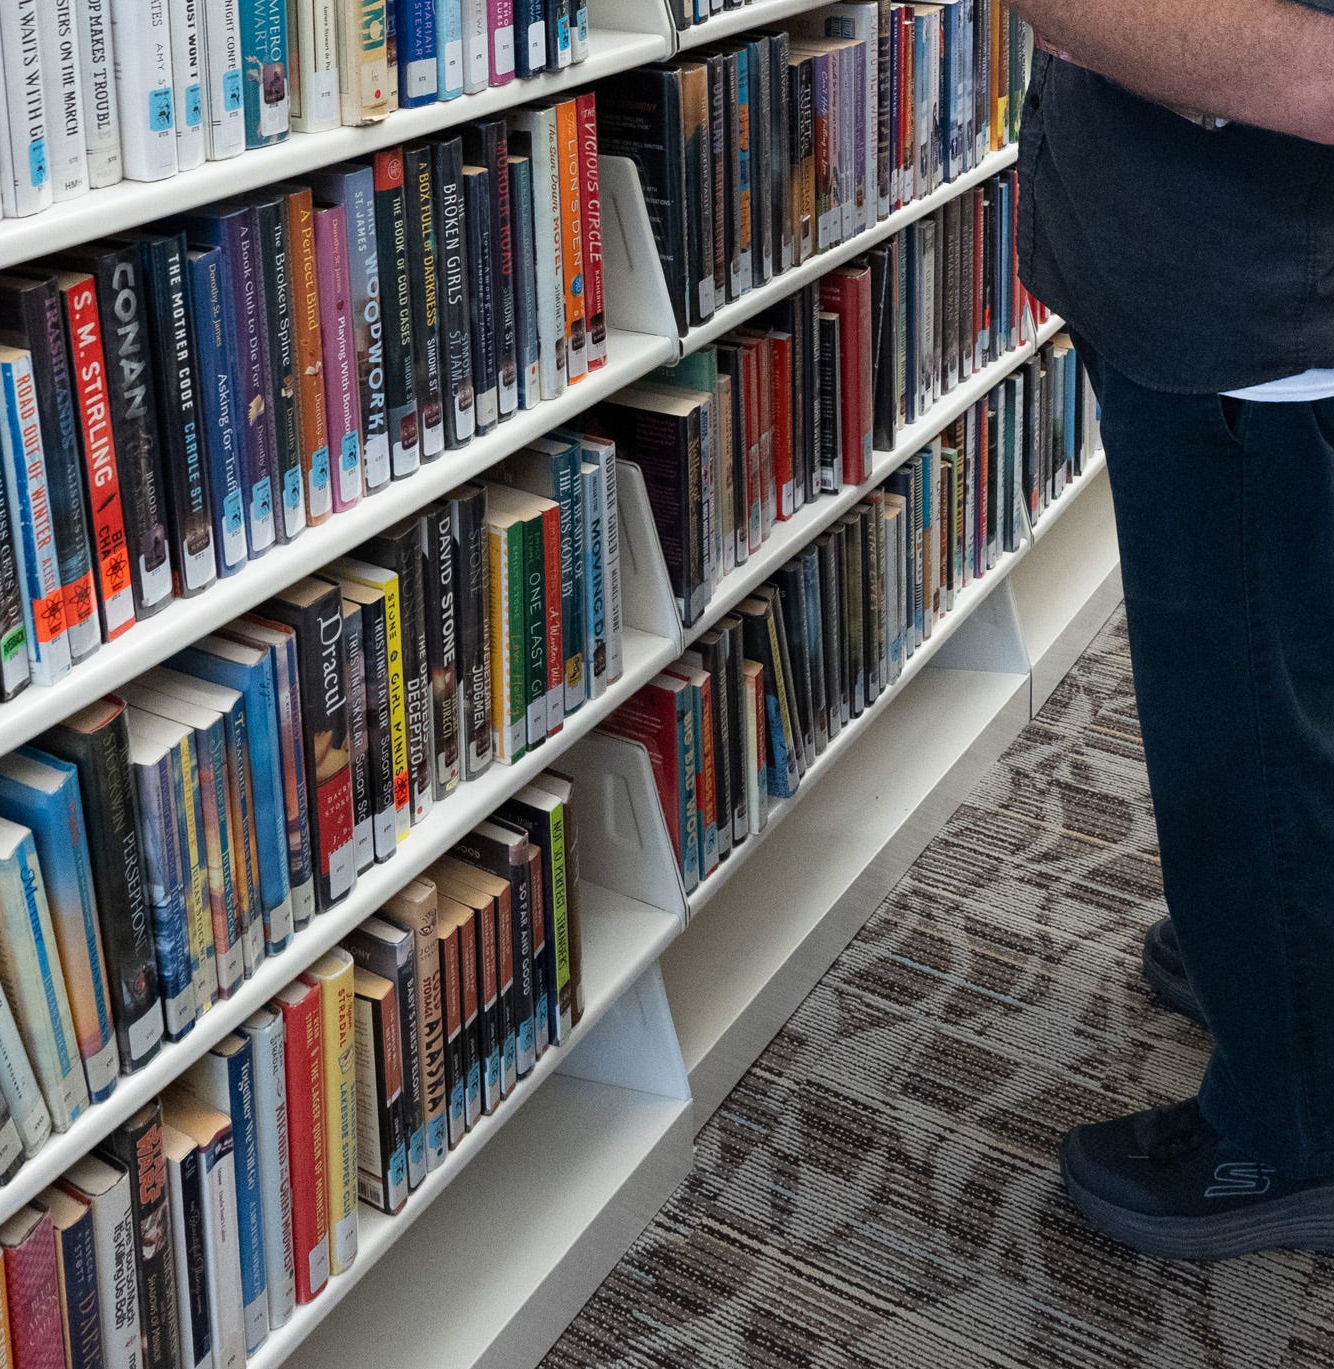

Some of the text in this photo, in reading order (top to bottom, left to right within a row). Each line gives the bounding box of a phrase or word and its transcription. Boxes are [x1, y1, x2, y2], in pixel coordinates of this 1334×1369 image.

[89, 9, 105, 66] MAKES
[301, 227, 316, 291] Perfect
[443, 182, 463, 306] BROKEN GIRLS
[588, 194, 603, 263] CIRCLE
[110, 261, 149, 422] CONAN
[172, 291, 194, 413] MOTHER CODE
[80, 363, 117, 490] STIRLING
[438, 515, 456, 667] DAVID STONE
[591, 518, 604, 616] MOVING
[318, 605, 347, 717] Dracul
[336, 987, 347, 1049] STRADAL
